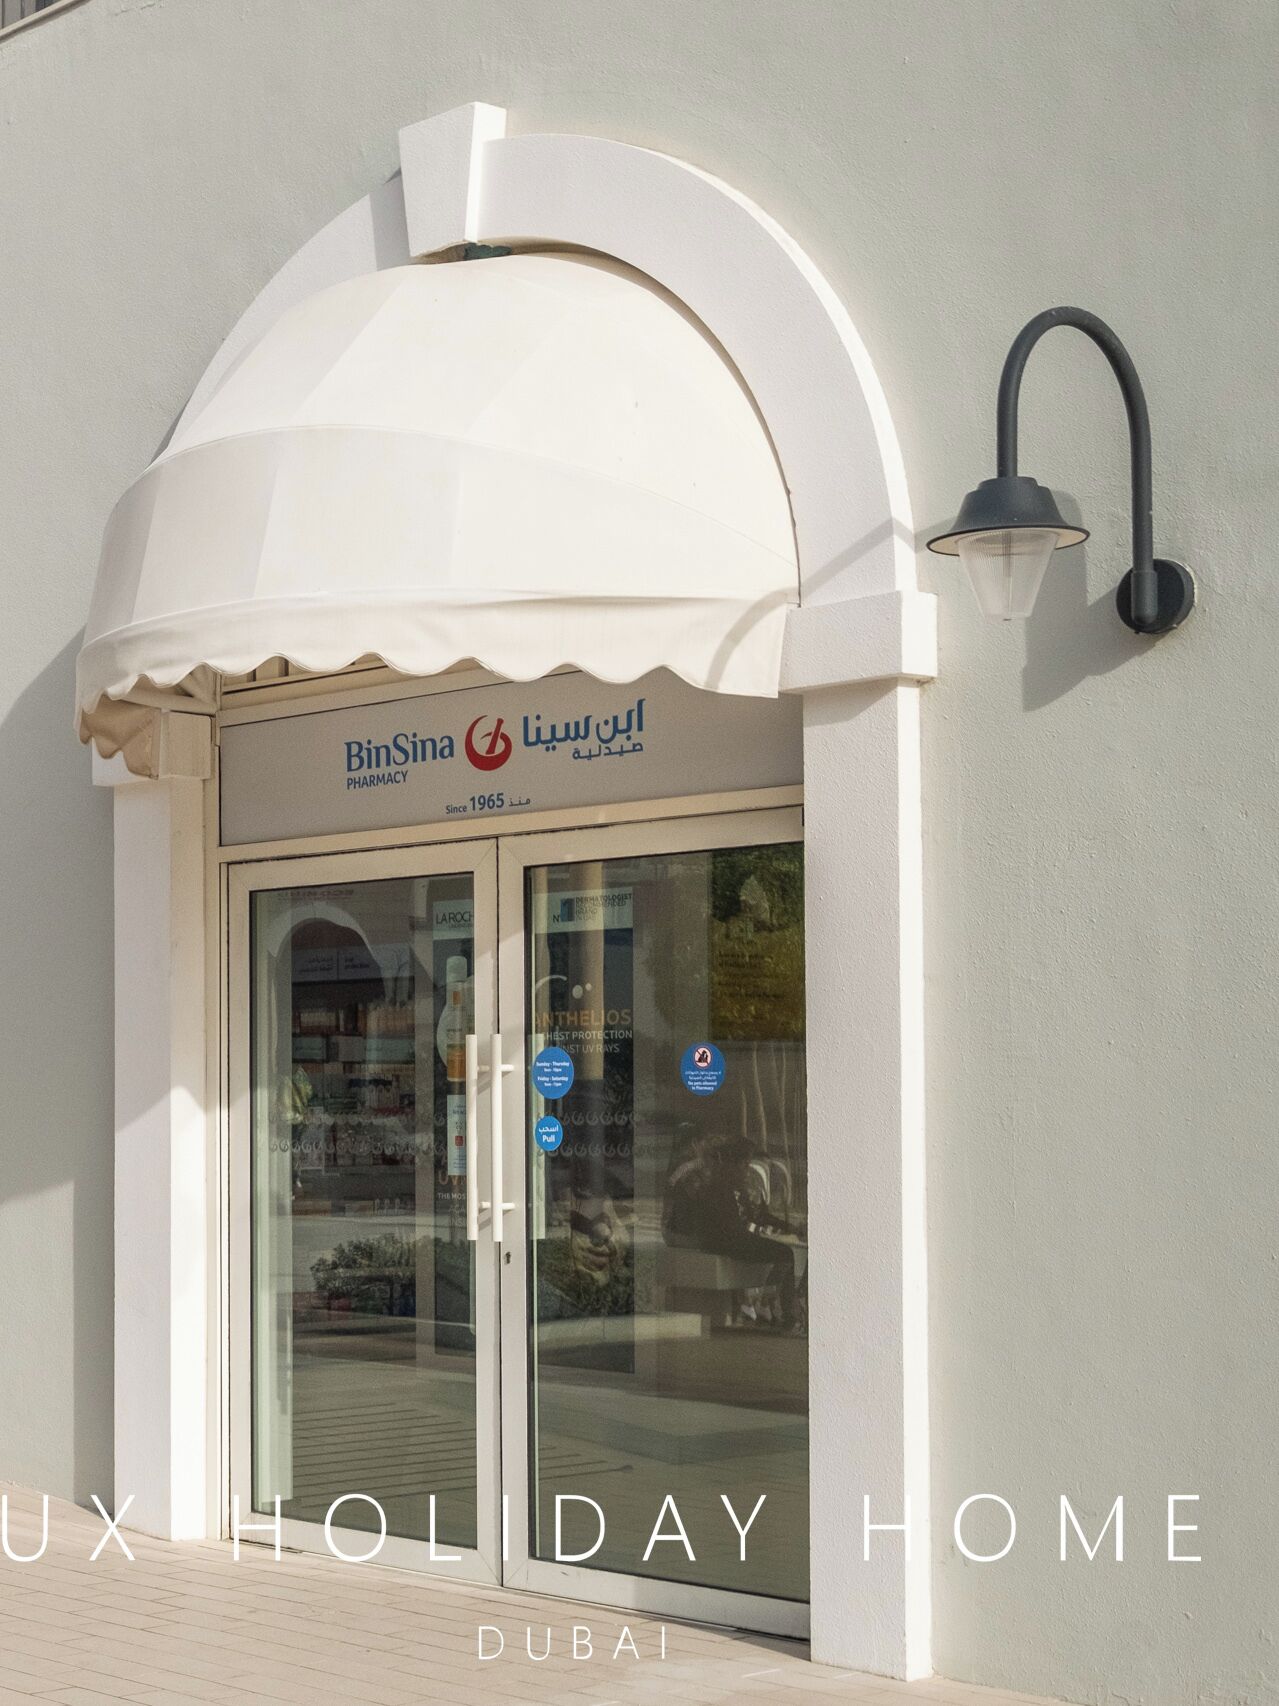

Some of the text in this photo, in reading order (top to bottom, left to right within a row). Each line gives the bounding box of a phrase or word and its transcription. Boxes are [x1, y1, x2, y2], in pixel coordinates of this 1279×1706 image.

[522, 698, 646, 753] ابن سينا
[344, 731, 455, 773] BinSina
[572, 743, 644, 761] صيدلية
[346, 770, 409, 790] PHARMACY
[445, 792, 505, 815] Since 1965
[571, 1030, 633, 1040] PROTECTION
[542, 1134, 556, 1143] Pull
